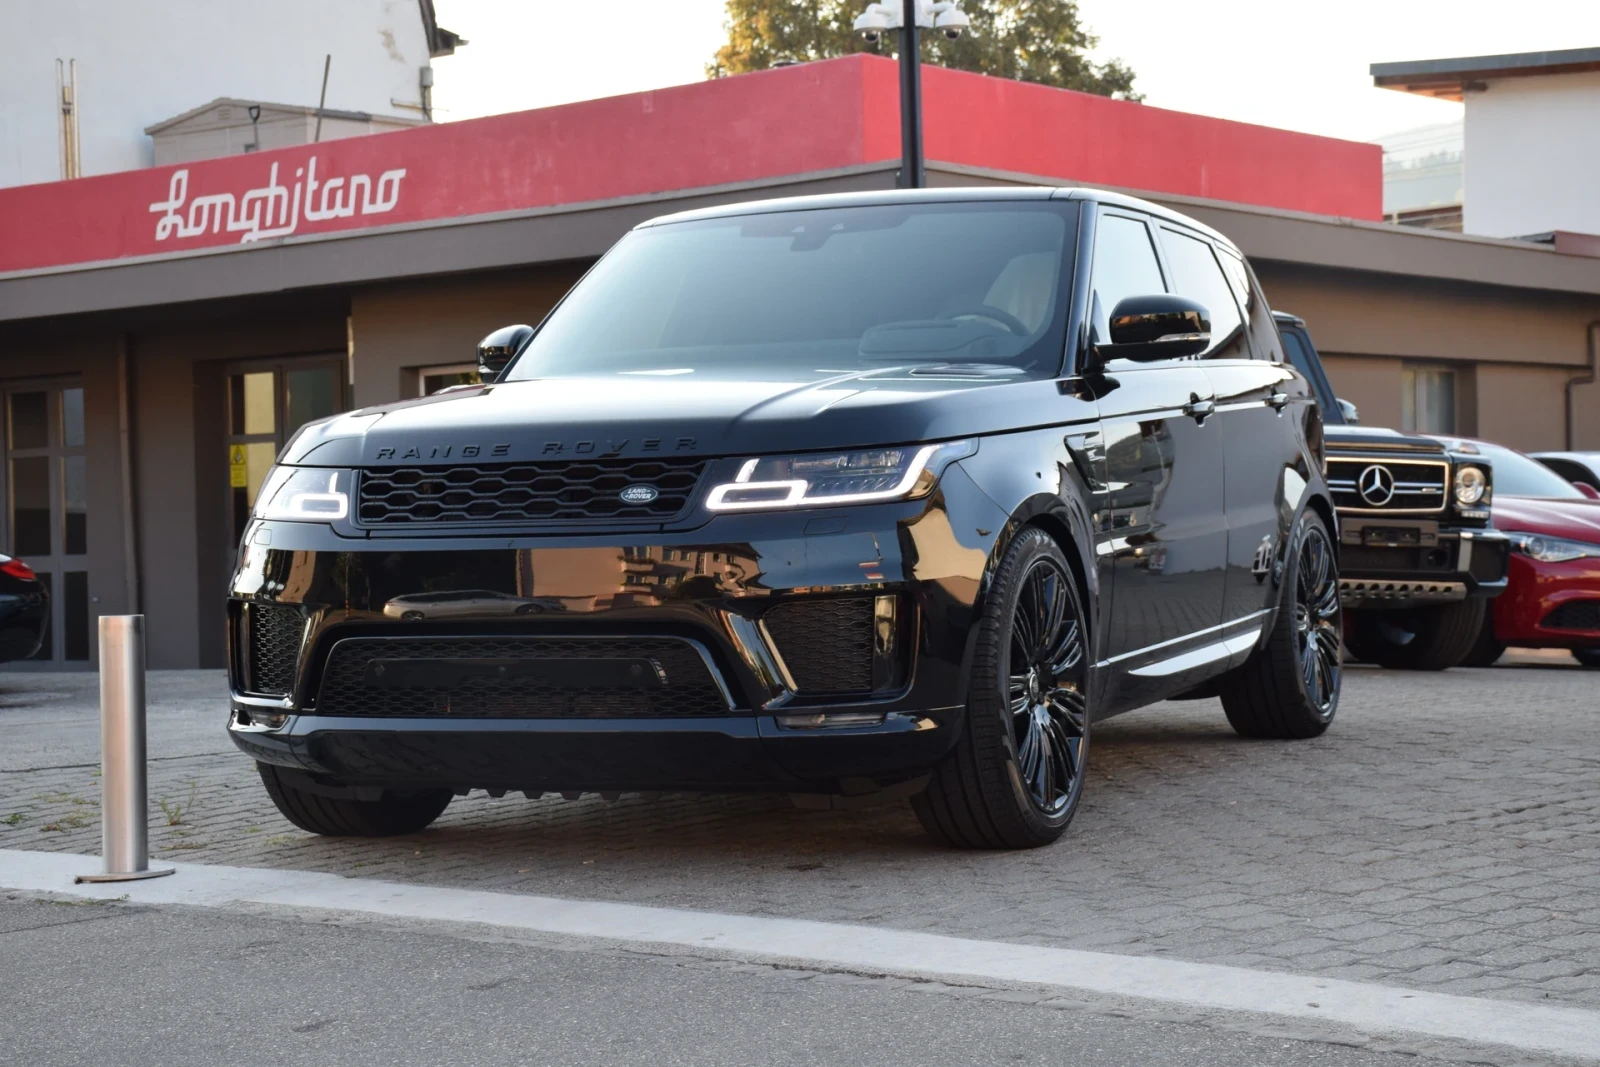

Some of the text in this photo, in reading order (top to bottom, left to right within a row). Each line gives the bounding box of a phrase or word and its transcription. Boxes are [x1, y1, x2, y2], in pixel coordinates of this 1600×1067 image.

[149, 156, 407, 244] Longhitano
[375, 436, 697, 460] RANGE ROVER
